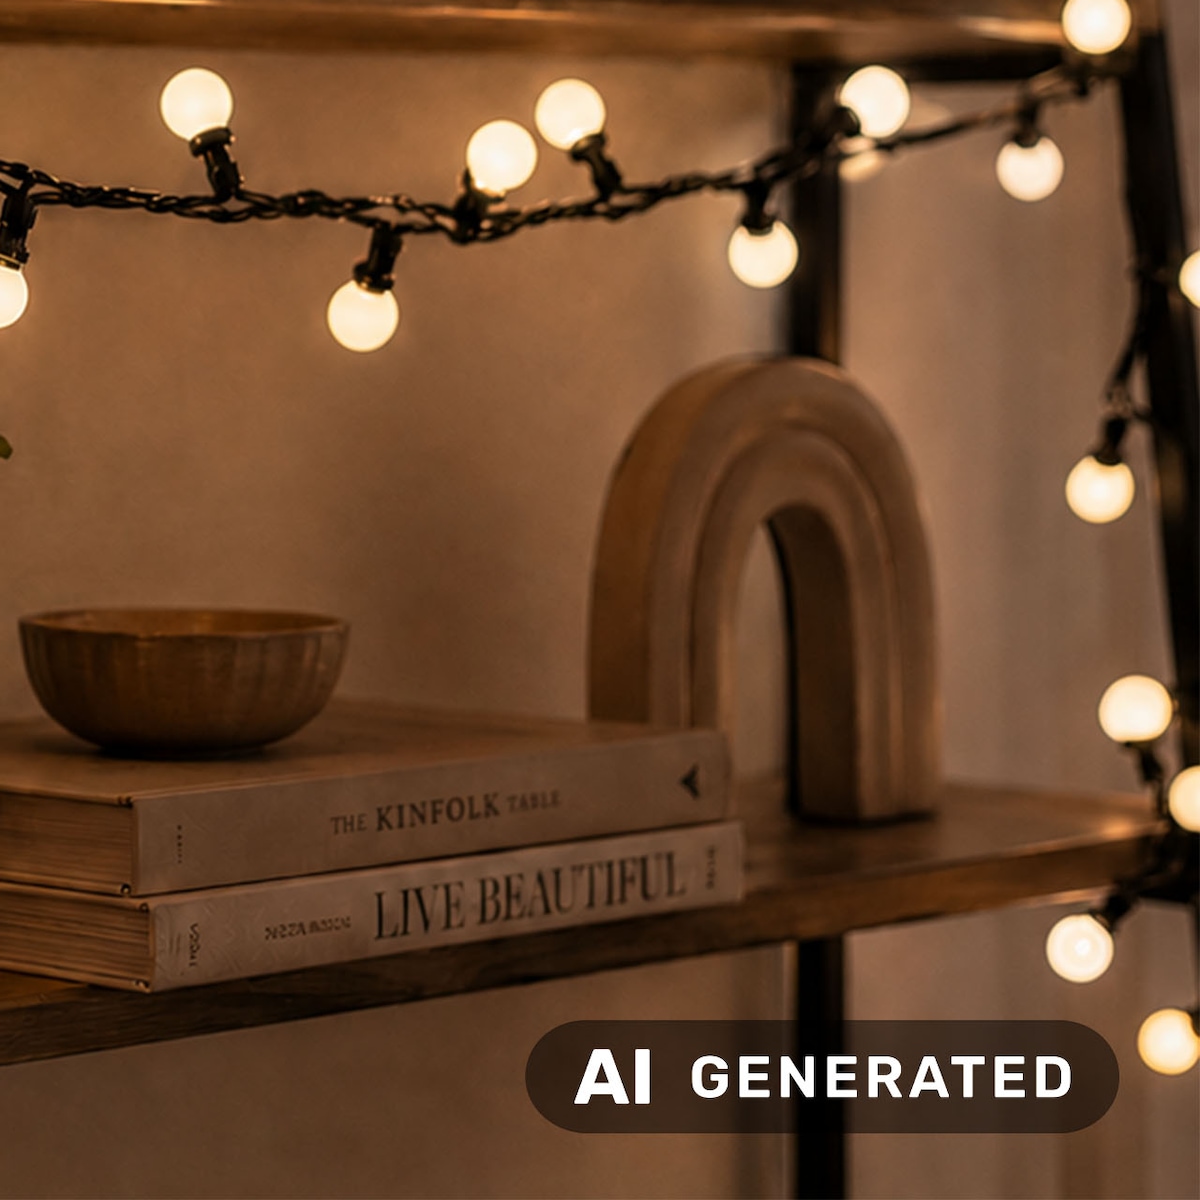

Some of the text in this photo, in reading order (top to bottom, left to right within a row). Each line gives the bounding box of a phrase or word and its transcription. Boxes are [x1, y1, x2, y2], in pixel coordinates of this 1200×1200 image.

[330, 813, 368, 835] THE
[375, 792, 501, 832] KINFOLK
[373, 881, 465, 941] LIVE
[476, 850, 687, 926] BEAUTIFUL
